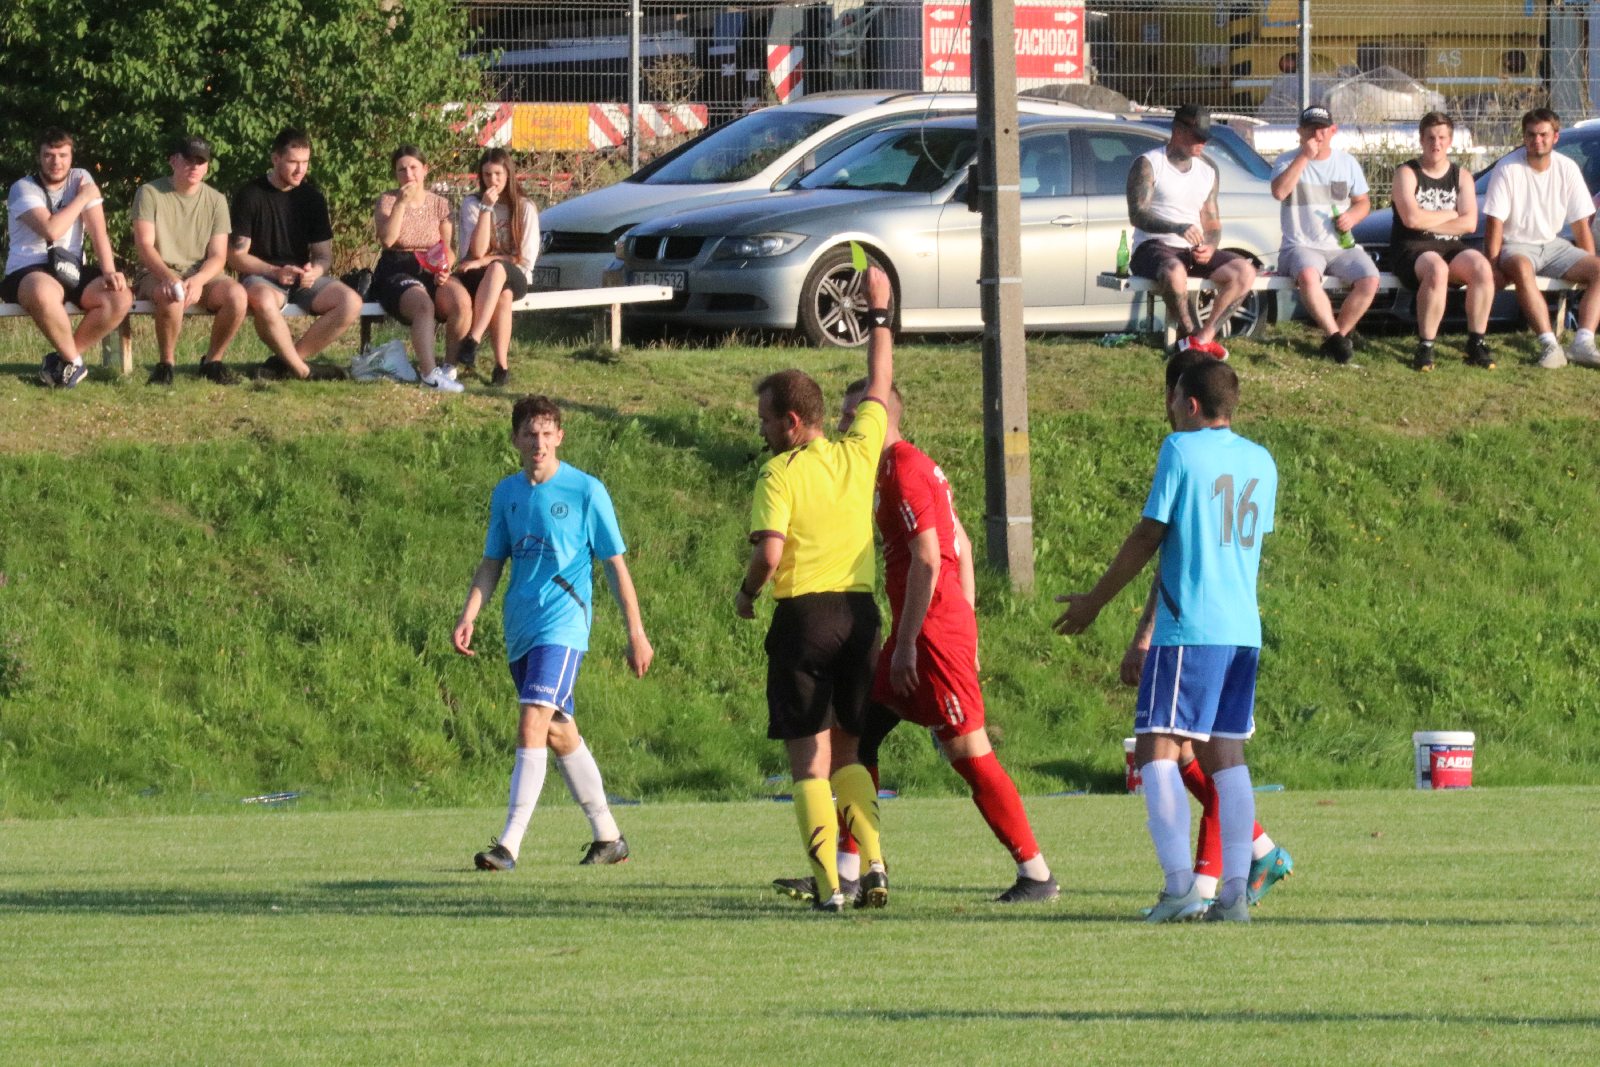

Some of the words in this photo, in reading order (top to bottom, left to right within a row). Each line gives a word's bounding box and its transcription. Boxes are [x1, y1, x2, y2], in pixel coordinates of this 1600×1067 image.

[930, 28, 971, 54] UWAG
[1014, 28, 1078, 56] ZACHODZI
[1210, 473, 1260, 550] 16
